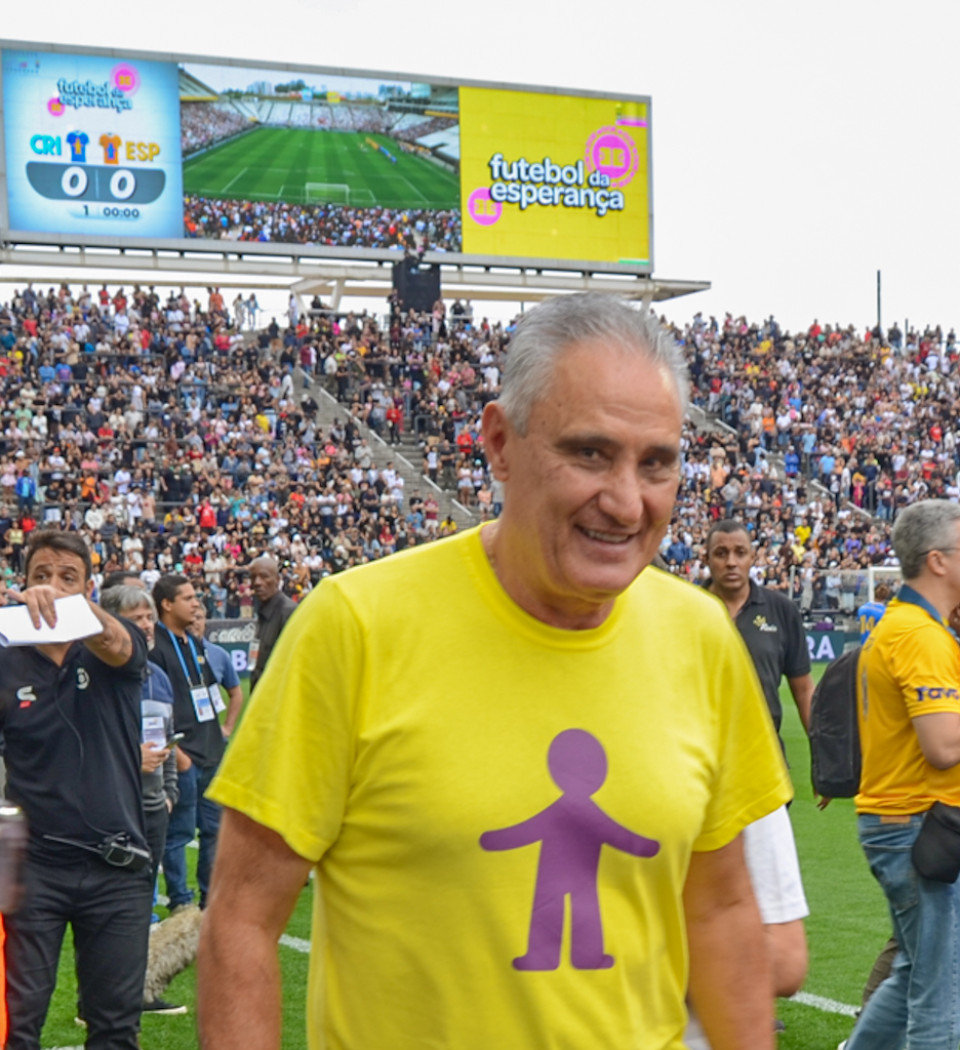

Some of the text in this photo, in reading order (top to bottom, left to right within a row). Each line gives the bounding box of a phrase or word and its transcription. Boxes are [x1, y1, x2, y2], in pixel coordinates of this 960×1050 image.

[30, 134, 62, 156] CRI
[125, 142, 160, 162] ESP
[61, 166, 87, 197] 0
[110, 169, 136, 200] 0
[489, 153, 584, 185] futebol
[588, 169, 610, 187] da
[83, 205, 140, 218] 1 00:00
[490, 181, 624, 217] esperança
